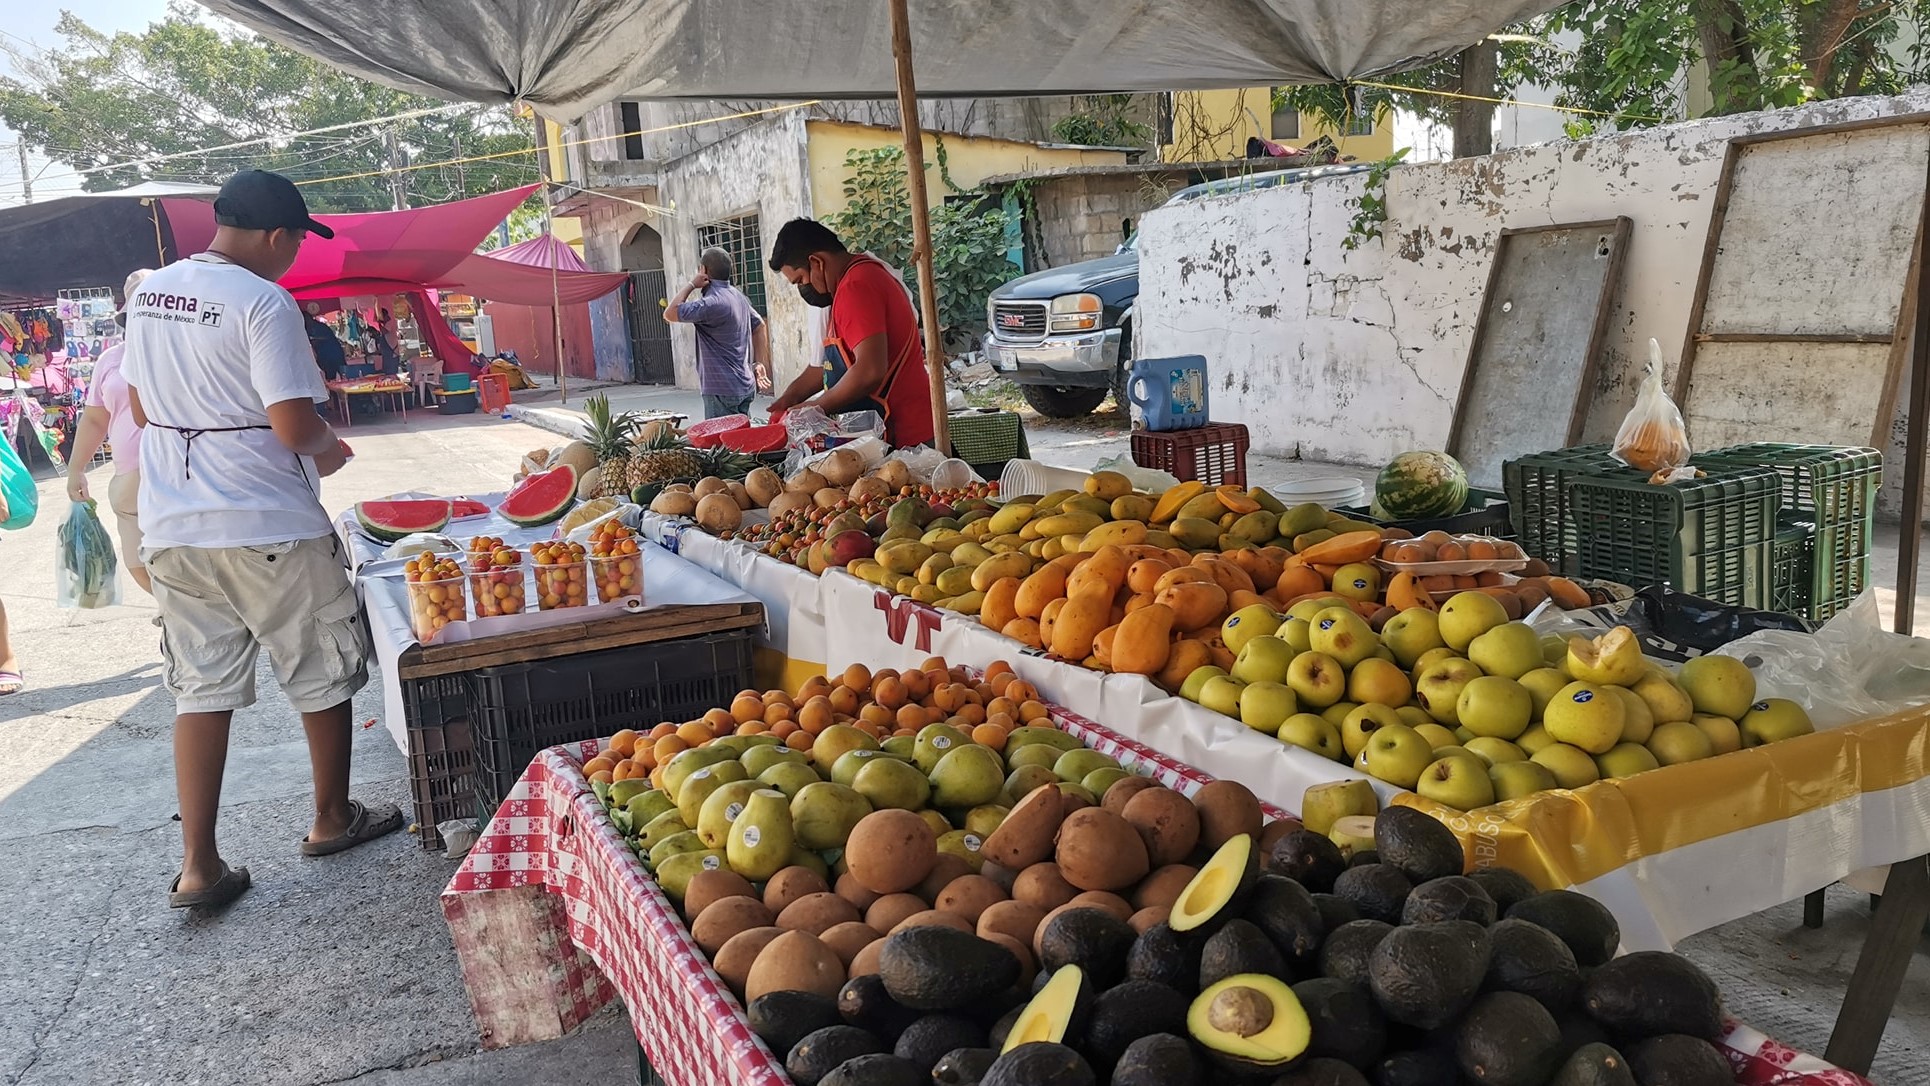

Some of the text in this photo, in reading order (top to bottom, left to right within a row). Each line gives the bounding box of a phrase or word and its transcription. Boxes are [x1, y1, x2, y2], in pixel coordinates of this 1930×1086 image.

[135, 292, 198, 312] morena
[163, 312, 173, 321] de
[201, 311, 220, 324] PT
[1004, 314, 1025, 327] GMC
